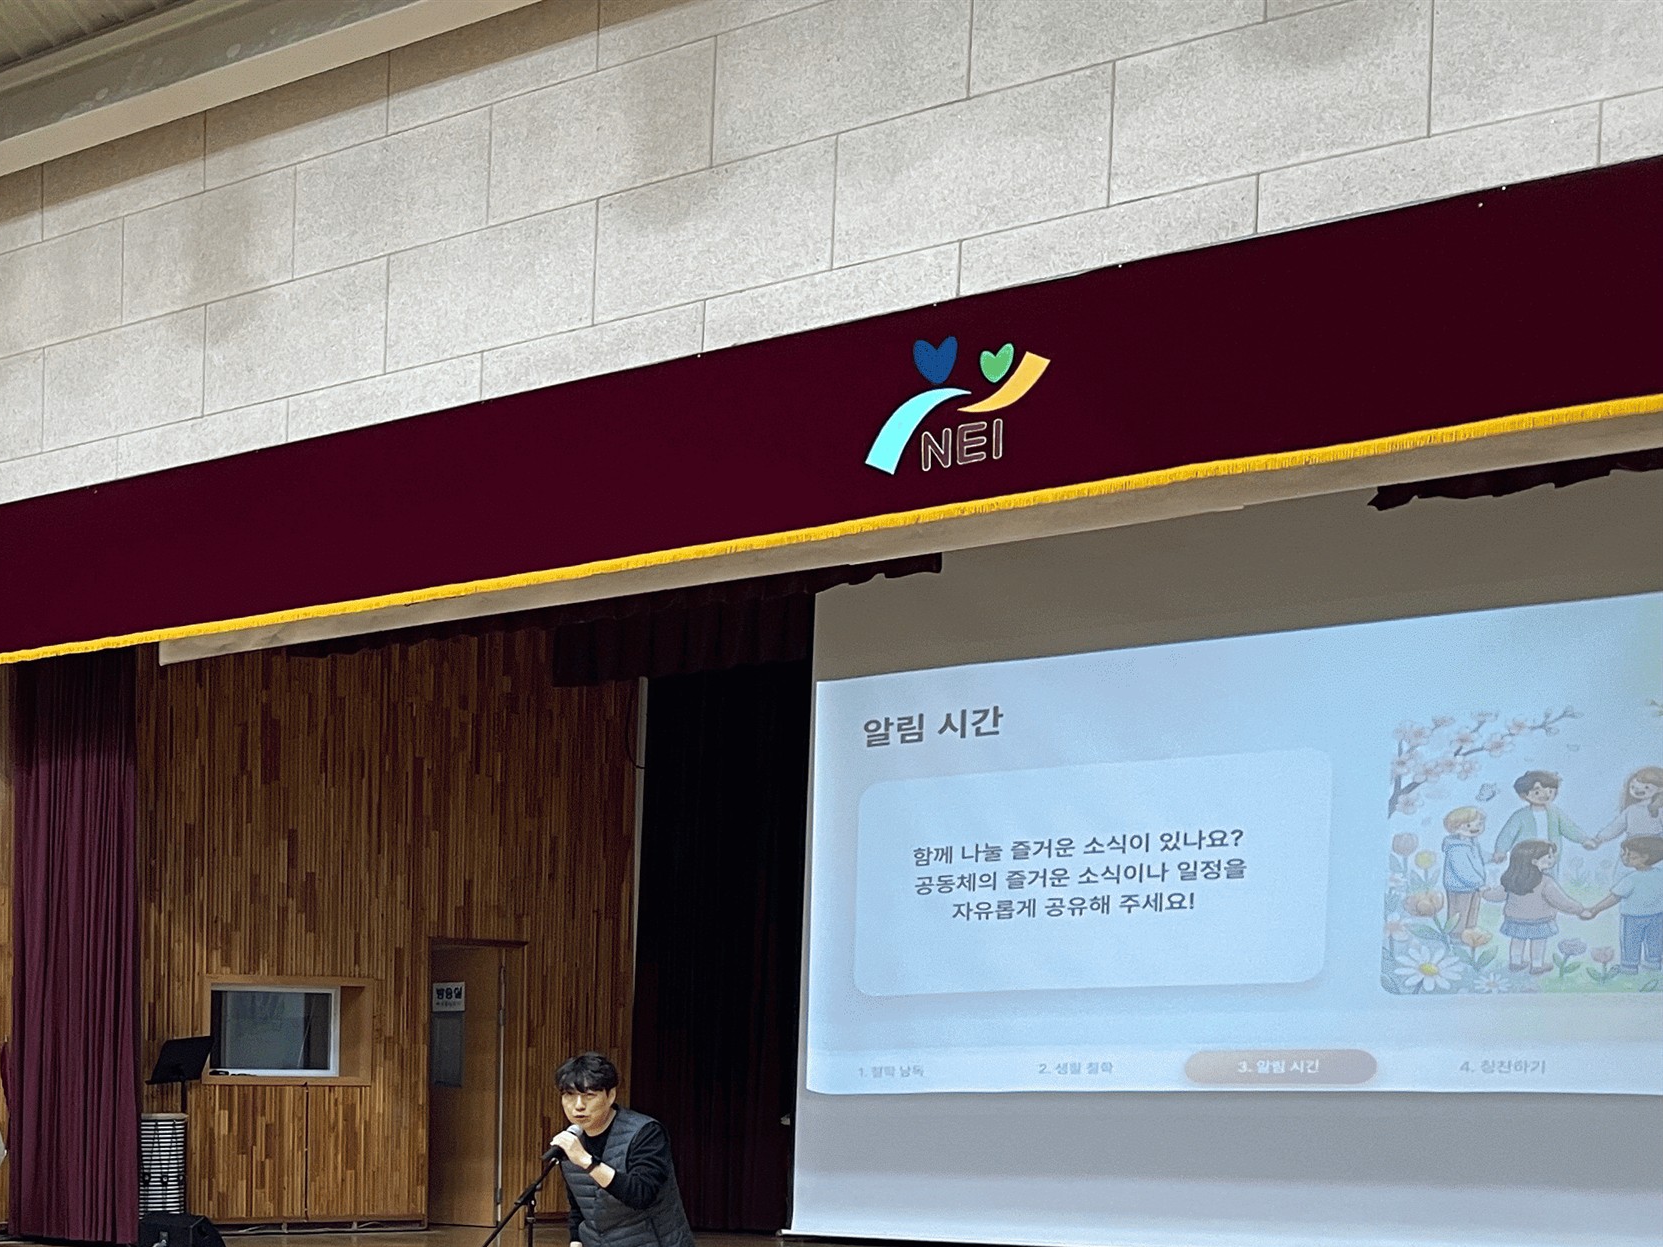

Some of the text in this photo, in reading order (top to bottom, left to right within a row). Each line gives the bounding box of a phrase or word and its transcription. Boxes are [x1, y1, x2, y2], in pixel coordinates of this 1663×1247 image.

[921, 418, 1003, 471] NEI
[863, 705, 1004, 747] 알림 시간
[913, 829, 1244, 867] 함께 나눌 즐거운 소식이 있나요?
[914, 858, 1247, 895] 공동체의 즐거운 소식이나 일정을
[952, 892, 1195, 921] 자유롭게 공유해 주세요!
[1237, 1060, 1252, 1073] 3.
[1290, 1059, 1319, 1074] 시간
[1460, 1061, 1475, 1073] 4.
